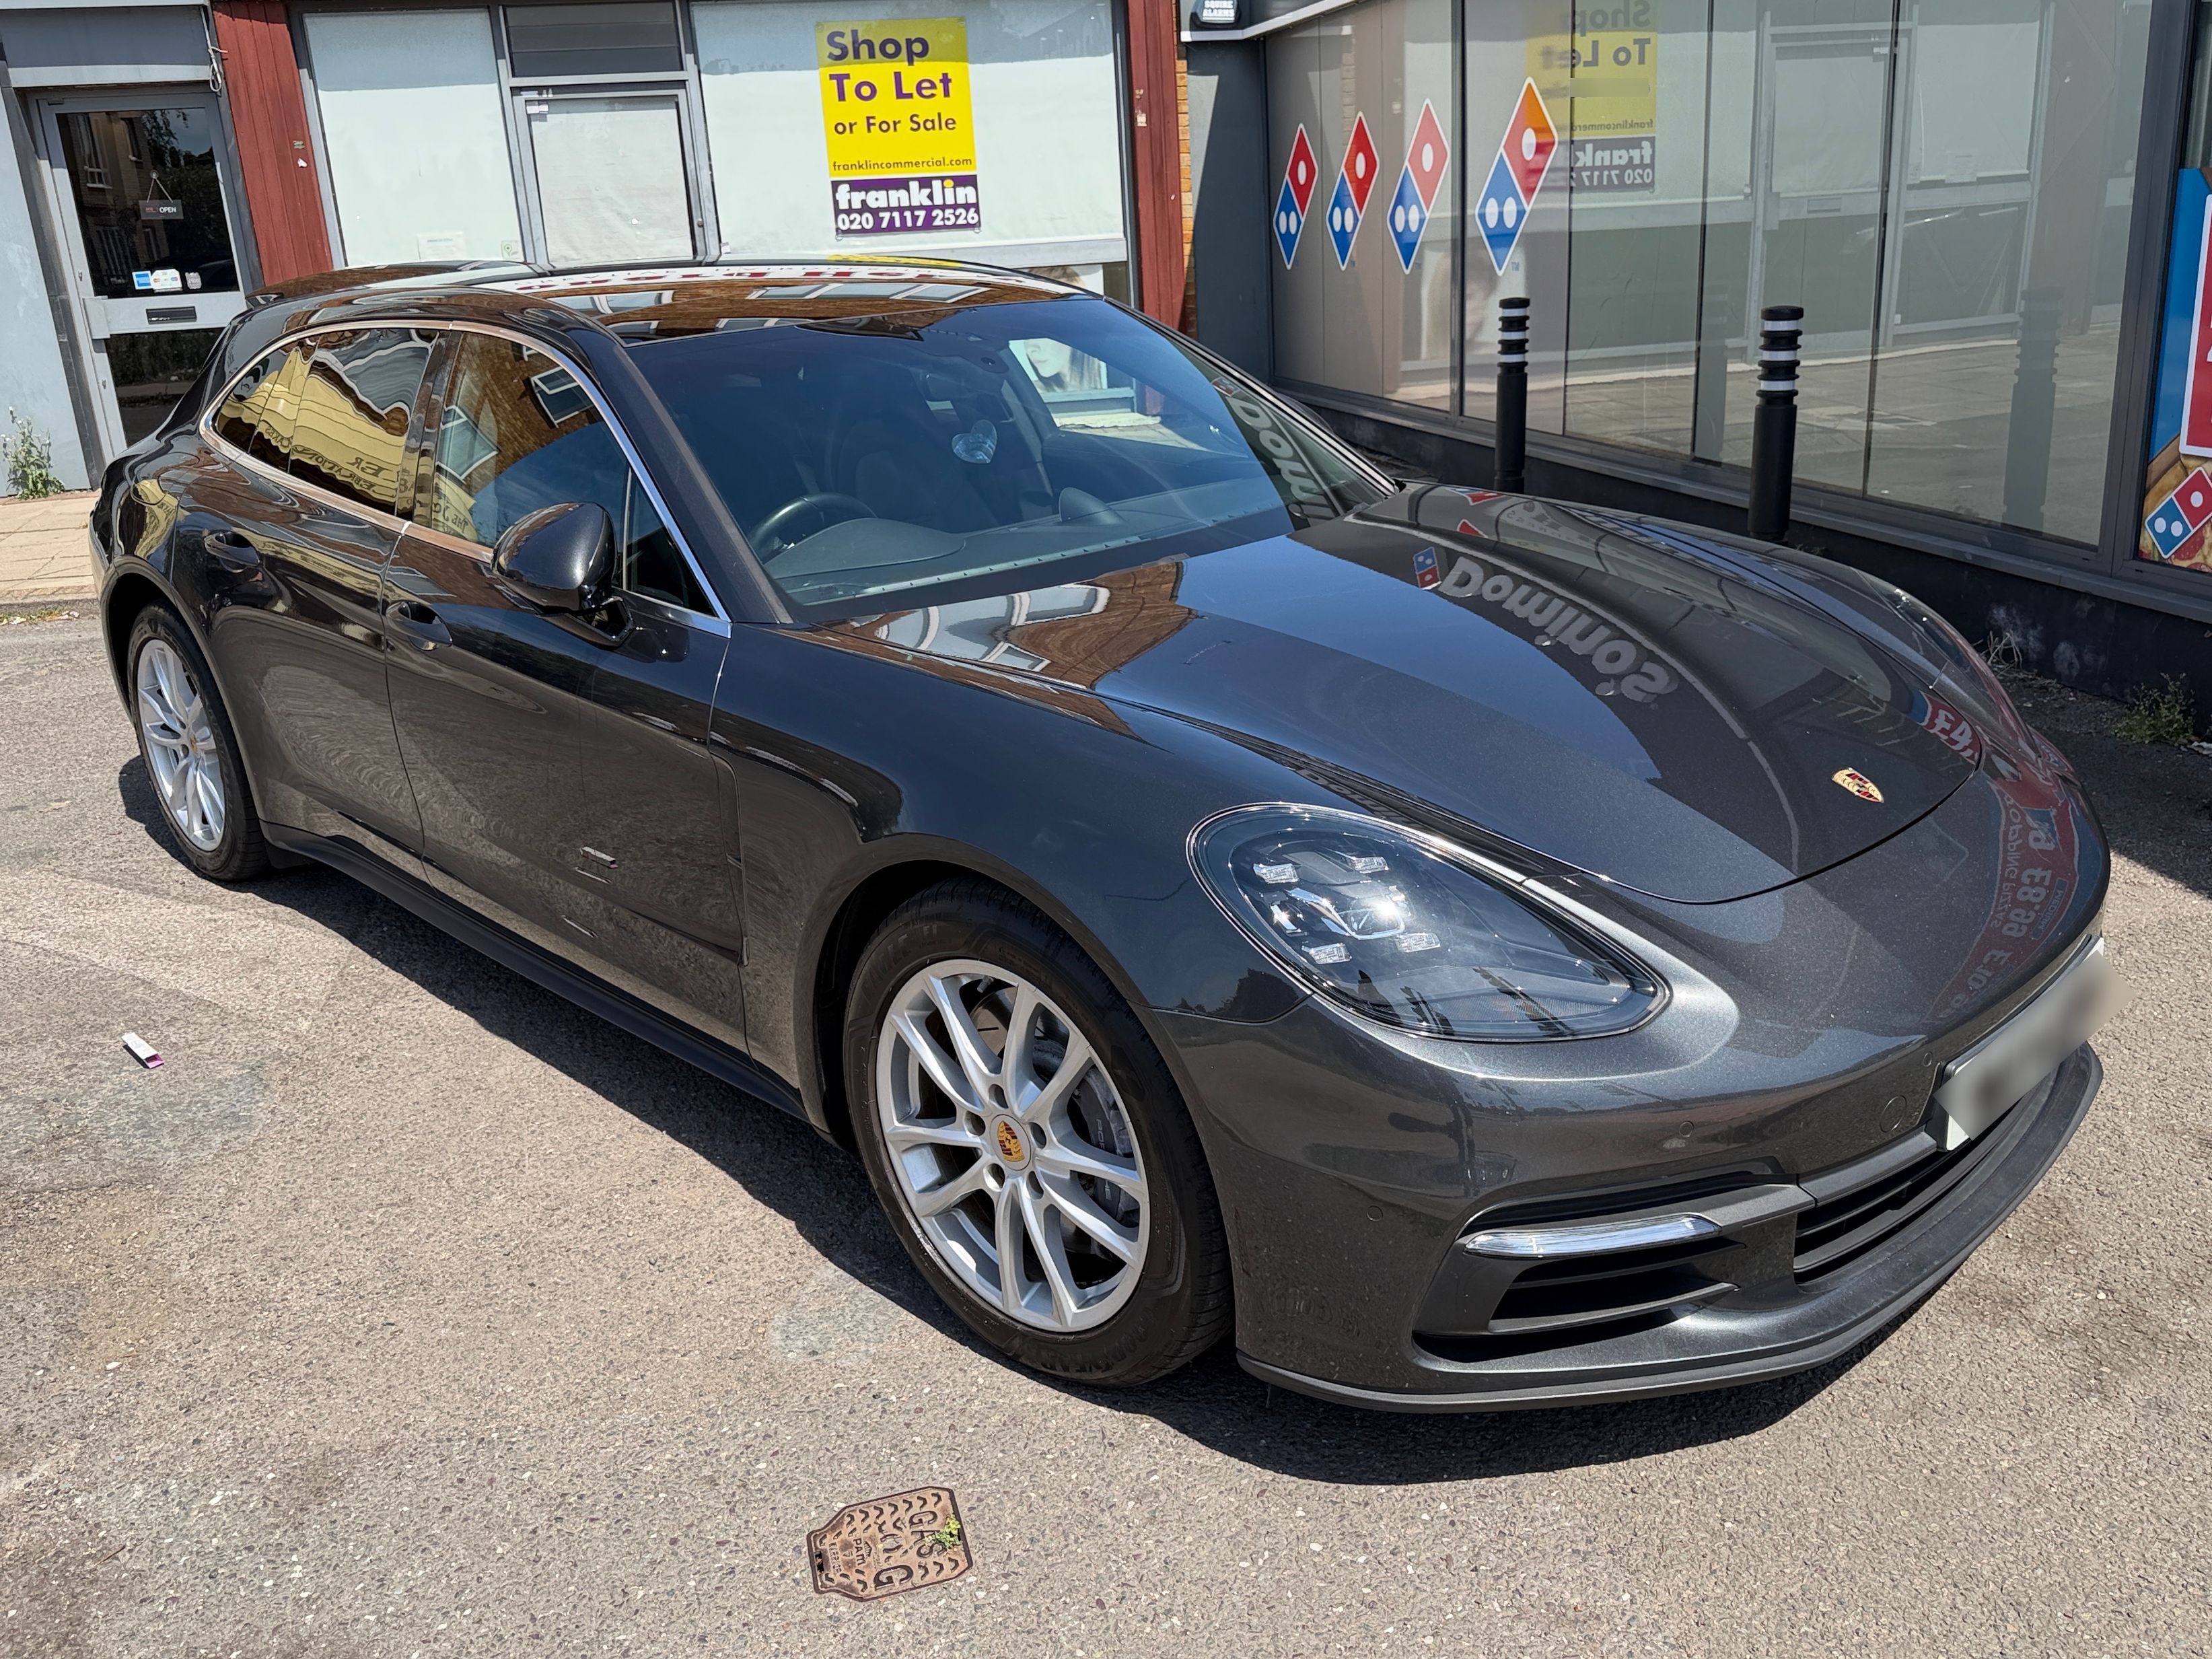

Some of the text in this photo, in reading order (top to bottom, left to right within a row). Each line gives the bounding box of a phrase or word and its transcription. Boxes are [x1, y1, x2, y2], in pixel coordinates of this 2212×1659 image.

[826, 29, 929, 66] Shop
[829, 71, 952, 102] To Let
[834, 112, 956, 135] or For Sale
[832, 157, 972, 171] franklincommercial.com
[835, 178, 977, 211] franklin
[836, 207, 979, 230] 020 7117 2526
[908, 1510, 948, 1559] GAS
[873, 1564, 914, 1591] G
